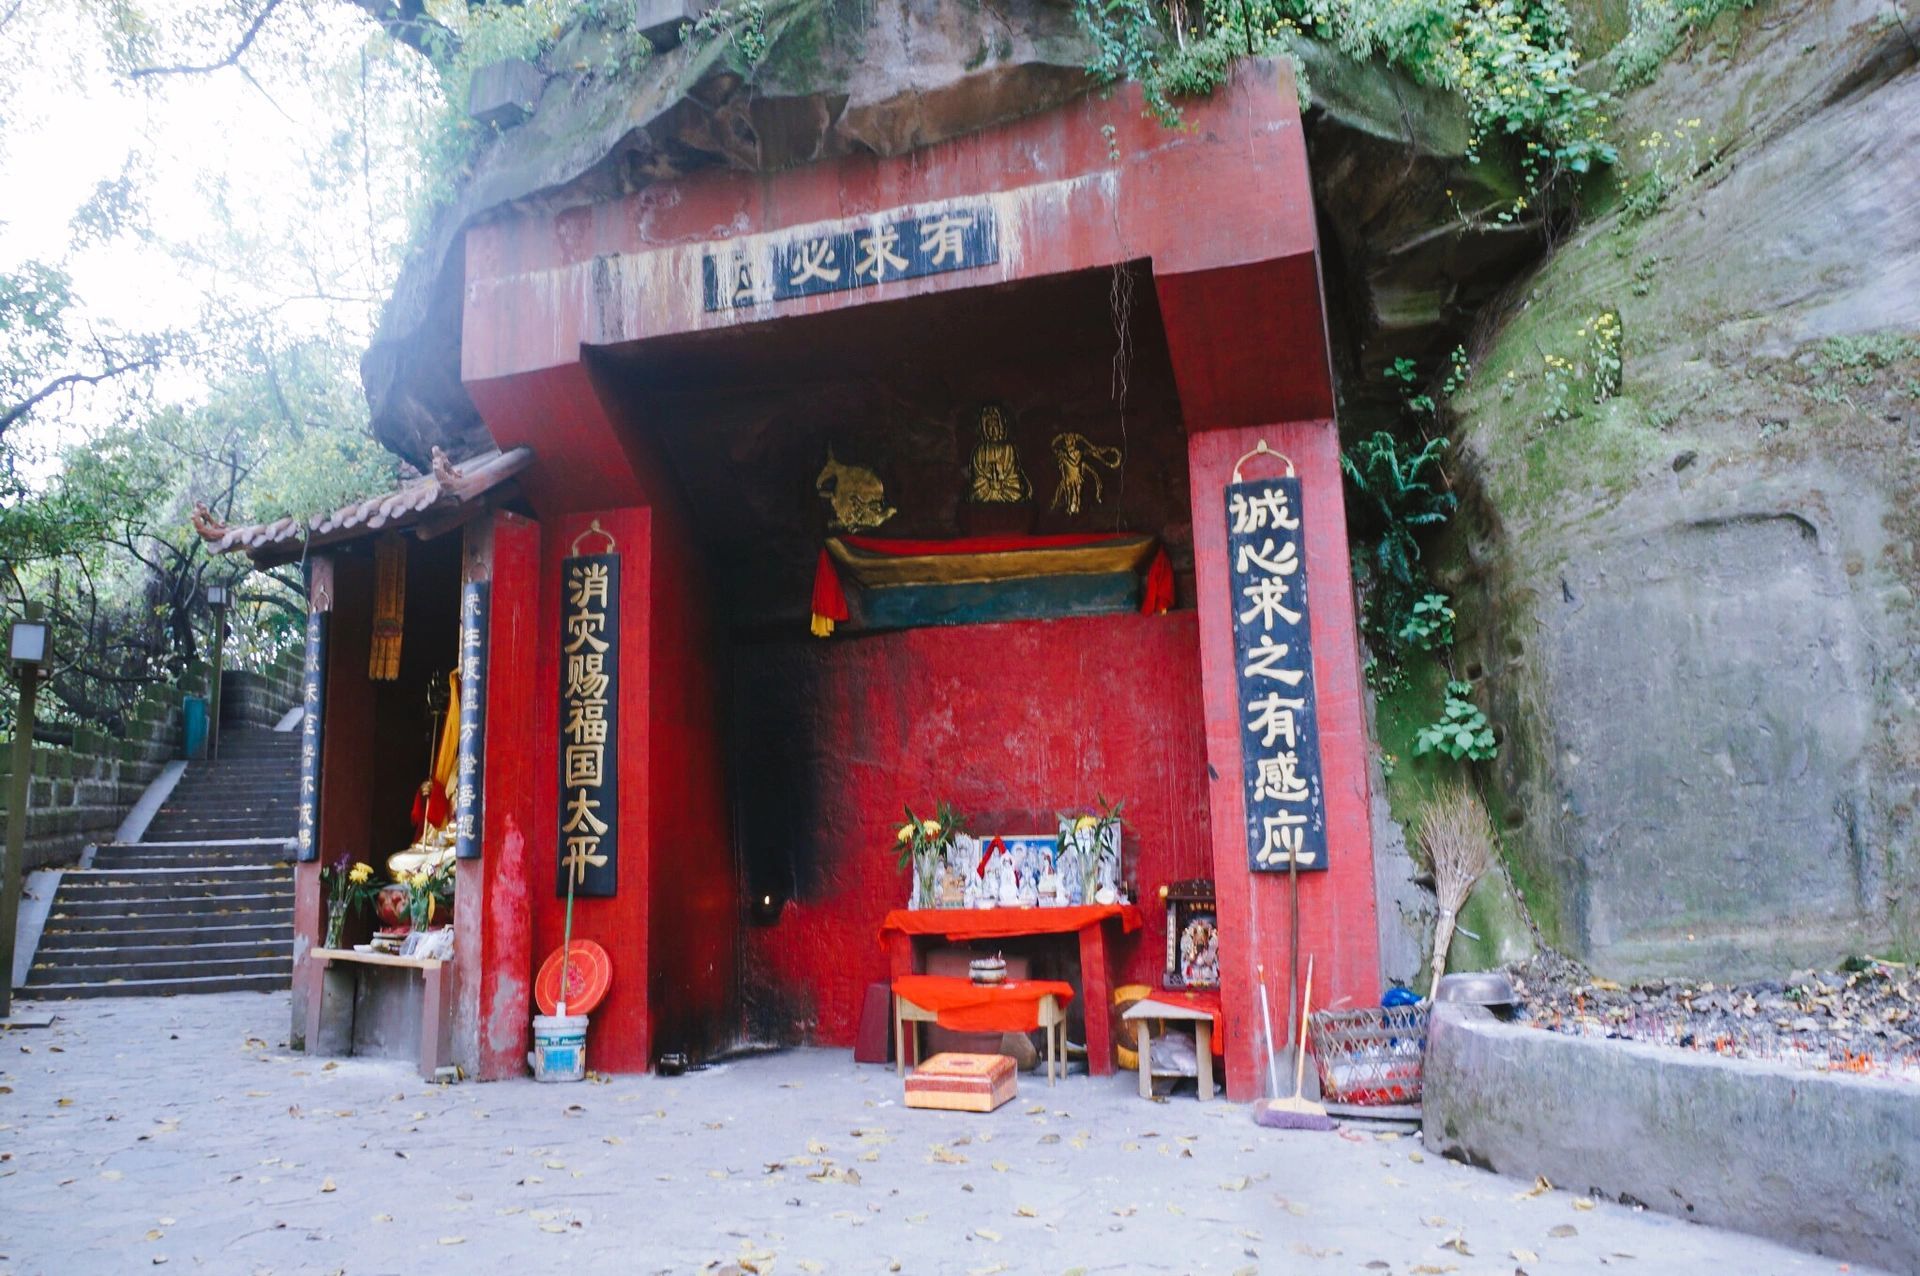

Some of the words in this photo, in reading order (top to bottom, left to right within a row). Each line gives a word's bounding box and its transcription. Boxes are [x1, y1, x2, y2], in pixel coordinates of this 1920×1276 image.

[562, 563, 609, 884] 消灾赐福国太平
[1229, 488, 1316, 866] 诚心求之有感应
